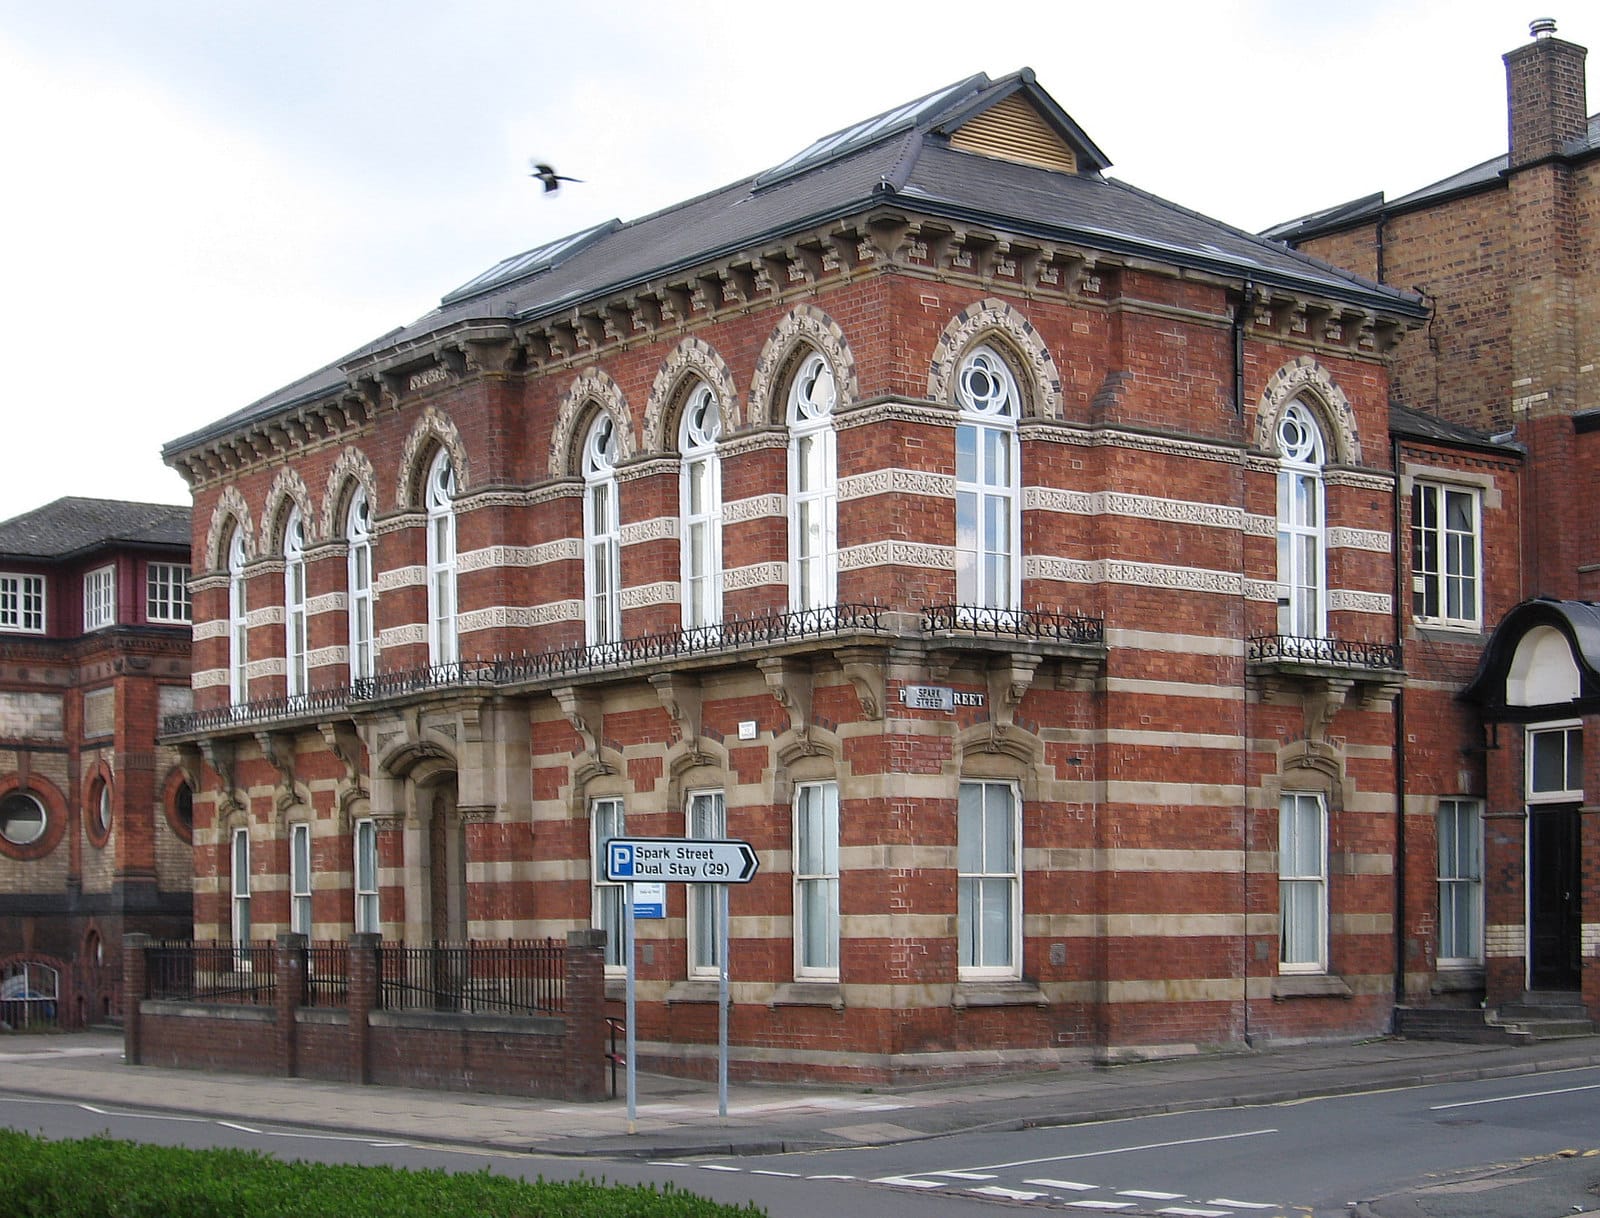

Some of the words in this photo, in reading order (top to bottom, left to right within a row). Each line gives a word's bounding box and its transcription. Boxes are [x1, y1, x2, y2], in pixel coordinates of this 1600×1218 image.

[918, 688, 940, 698] SPARK
[953, 693, 984, 706] REET
[916, 698, 943, 708] STREET
[635, 846, 670, 860] Spark
[676, 847, 714, 860] Street
[613, 847, 630, 873] P
[635, 862, 663, 875] Dual
[669, 863, 697, 877] Stay
[702, 862, 730, 877] (29)
